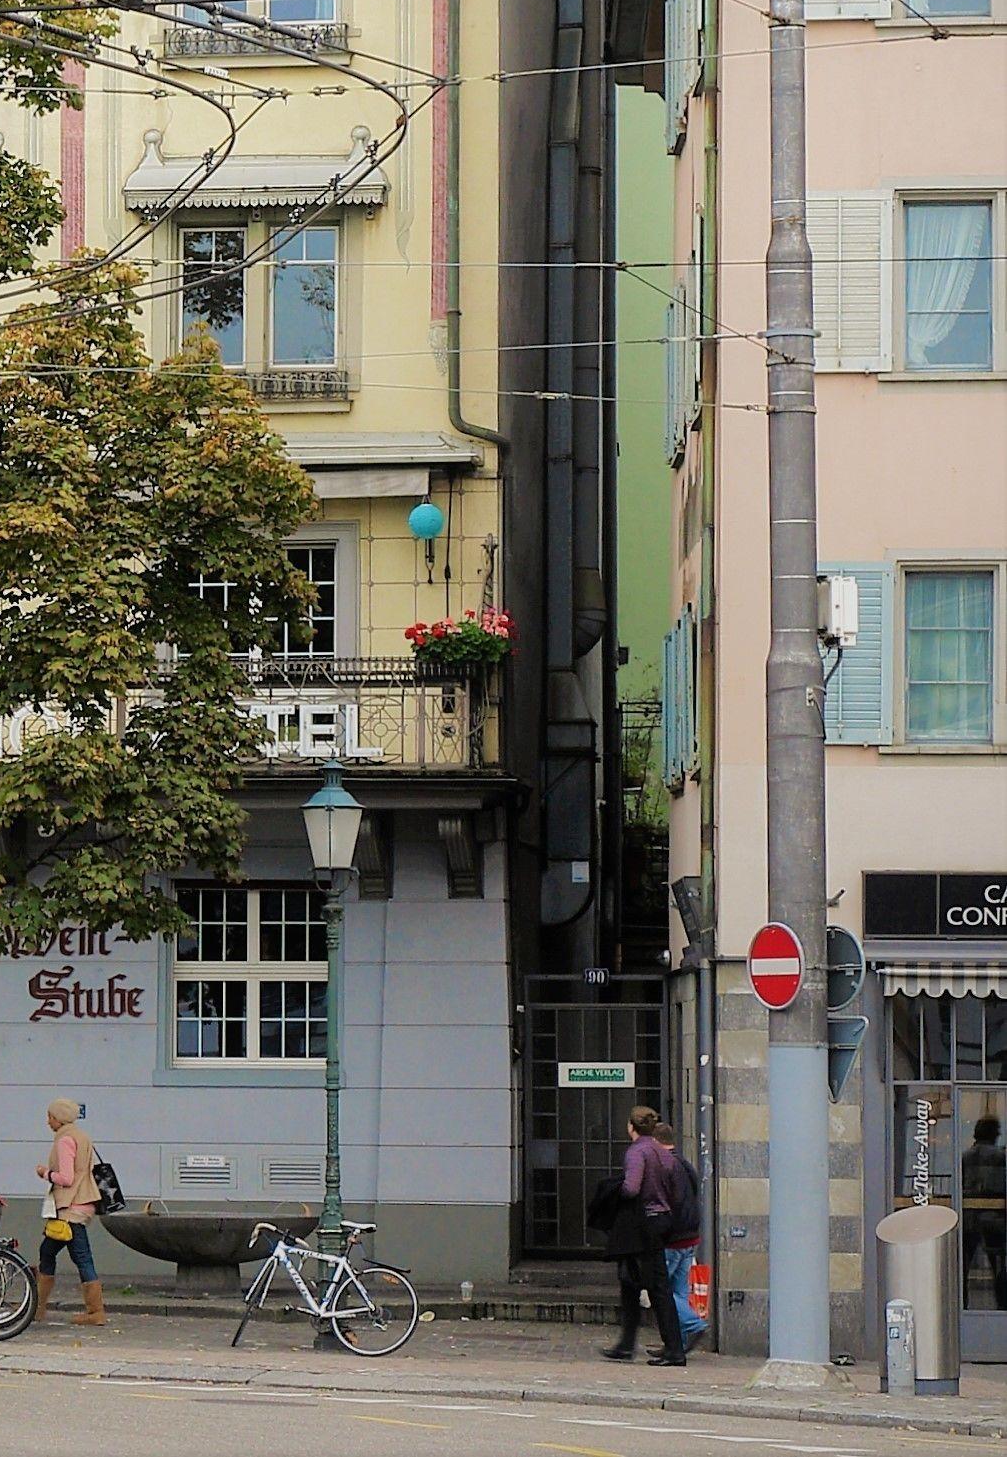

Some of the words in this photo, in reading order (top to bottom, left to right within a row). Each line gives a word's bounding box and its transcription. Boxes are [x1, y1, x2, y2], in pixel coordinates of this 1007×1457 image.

[28, 965, 145, 1023] Stube
[588, 970, 605, 984] 90
[913, 1098, 933, 1193] Take-Away
